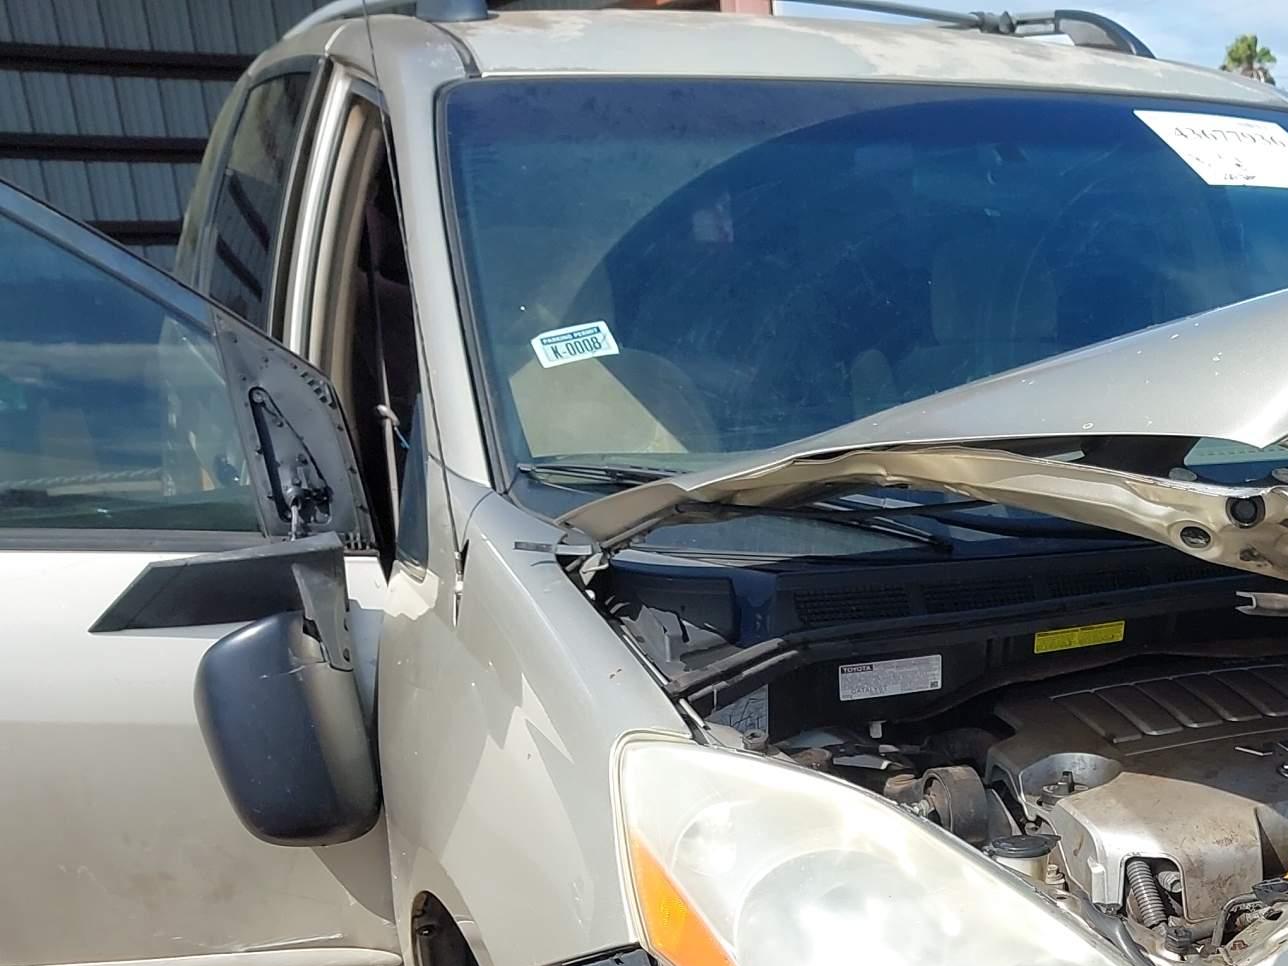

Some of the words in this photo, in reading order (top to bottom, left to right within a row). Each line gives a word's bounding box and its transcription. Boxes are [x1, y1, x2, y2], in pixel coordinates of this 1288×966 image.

[1173, 126, 1287, 149] 43677936
[550, 336, 603, 360] K-0008
[842, 665, 872, 674] TOYOTA
